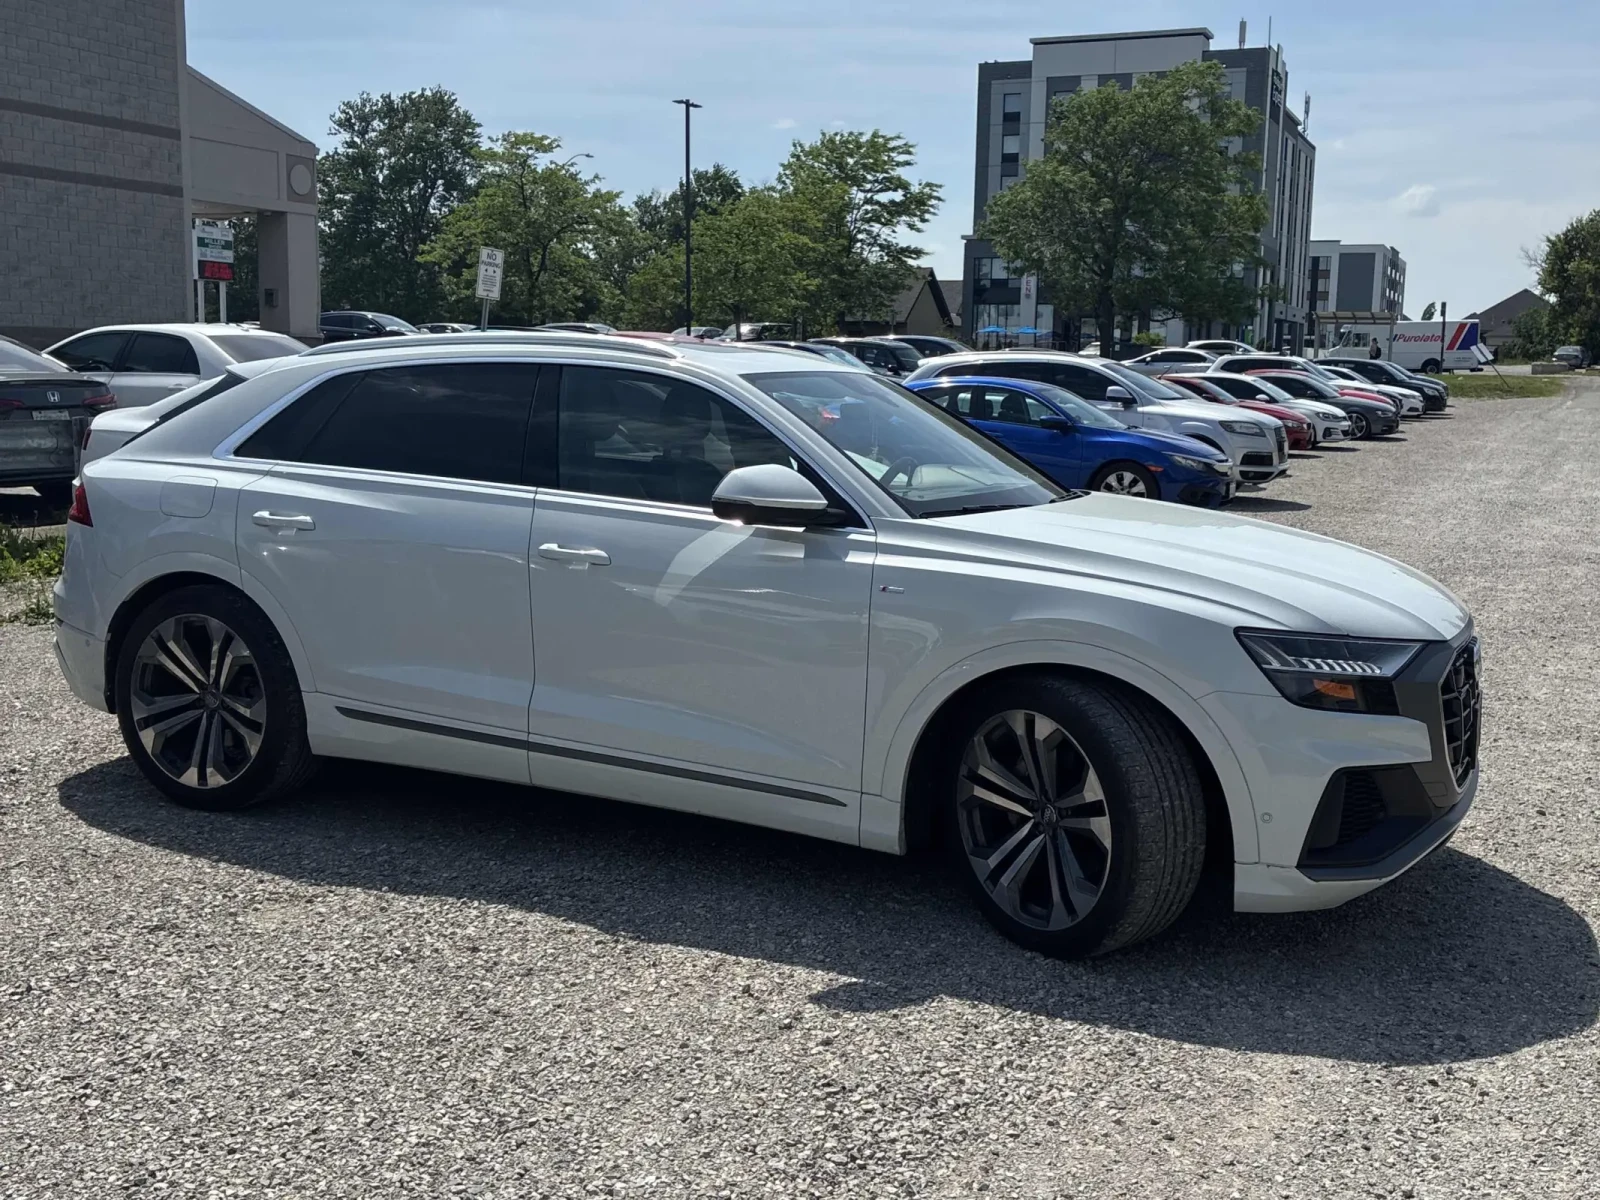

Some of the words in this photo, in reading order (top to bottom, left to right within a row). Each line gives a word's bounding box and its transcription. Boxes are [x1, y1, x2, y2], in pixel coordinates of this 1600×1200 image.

[486, 252, 497, 261] NO
[481, 260, 501, 269] PARKING
[1397, 334, 1444, 342] Purolato
